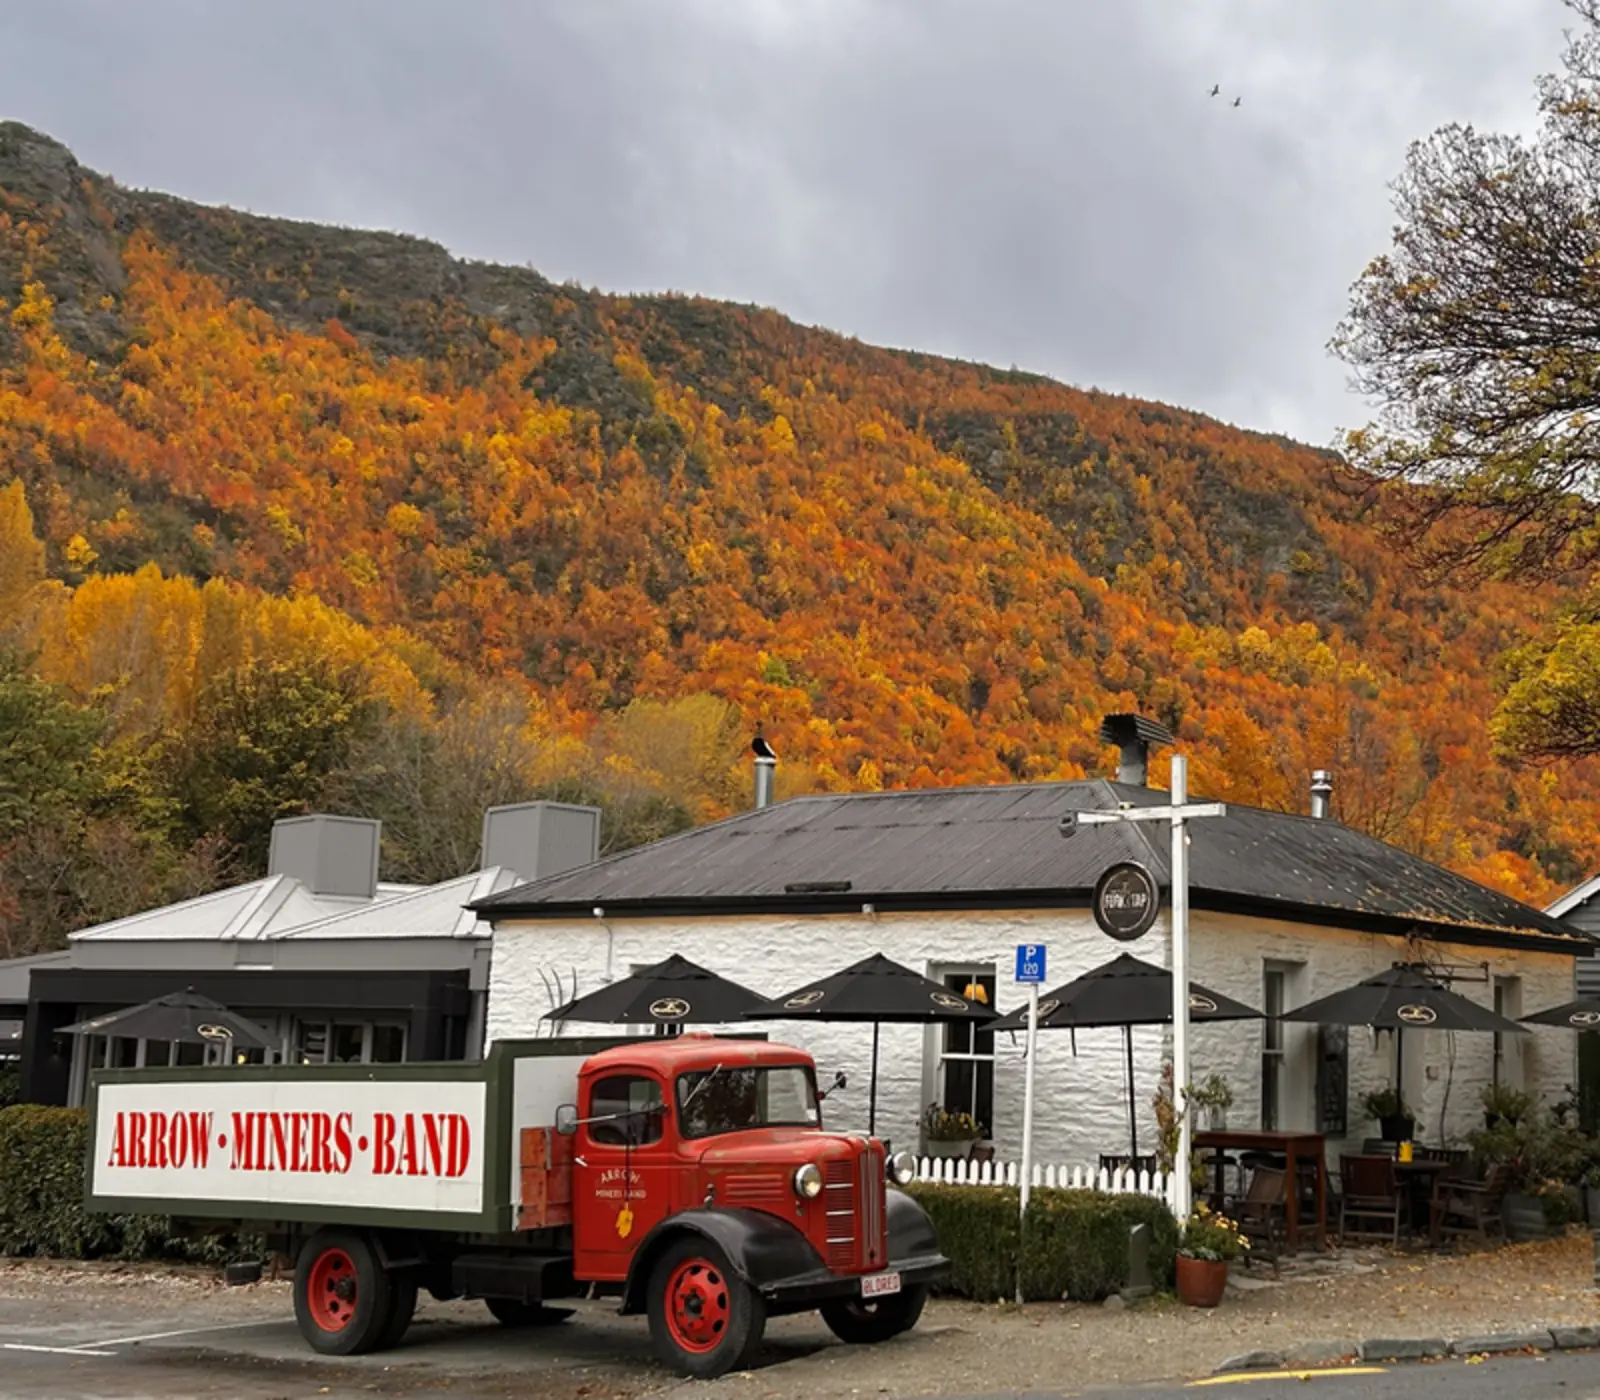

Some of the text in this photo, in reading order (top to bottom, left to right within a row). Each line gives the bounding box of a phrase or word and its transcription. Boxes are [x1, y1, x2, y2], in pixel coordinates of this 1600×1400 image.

[1026, 946, 1037, 961] P
[1024, 962, 1038, 975] 120
[107, 1111, 471, 1178] ARROW MINERS BAND
[601, 1169, 641, 1184] ARROW
